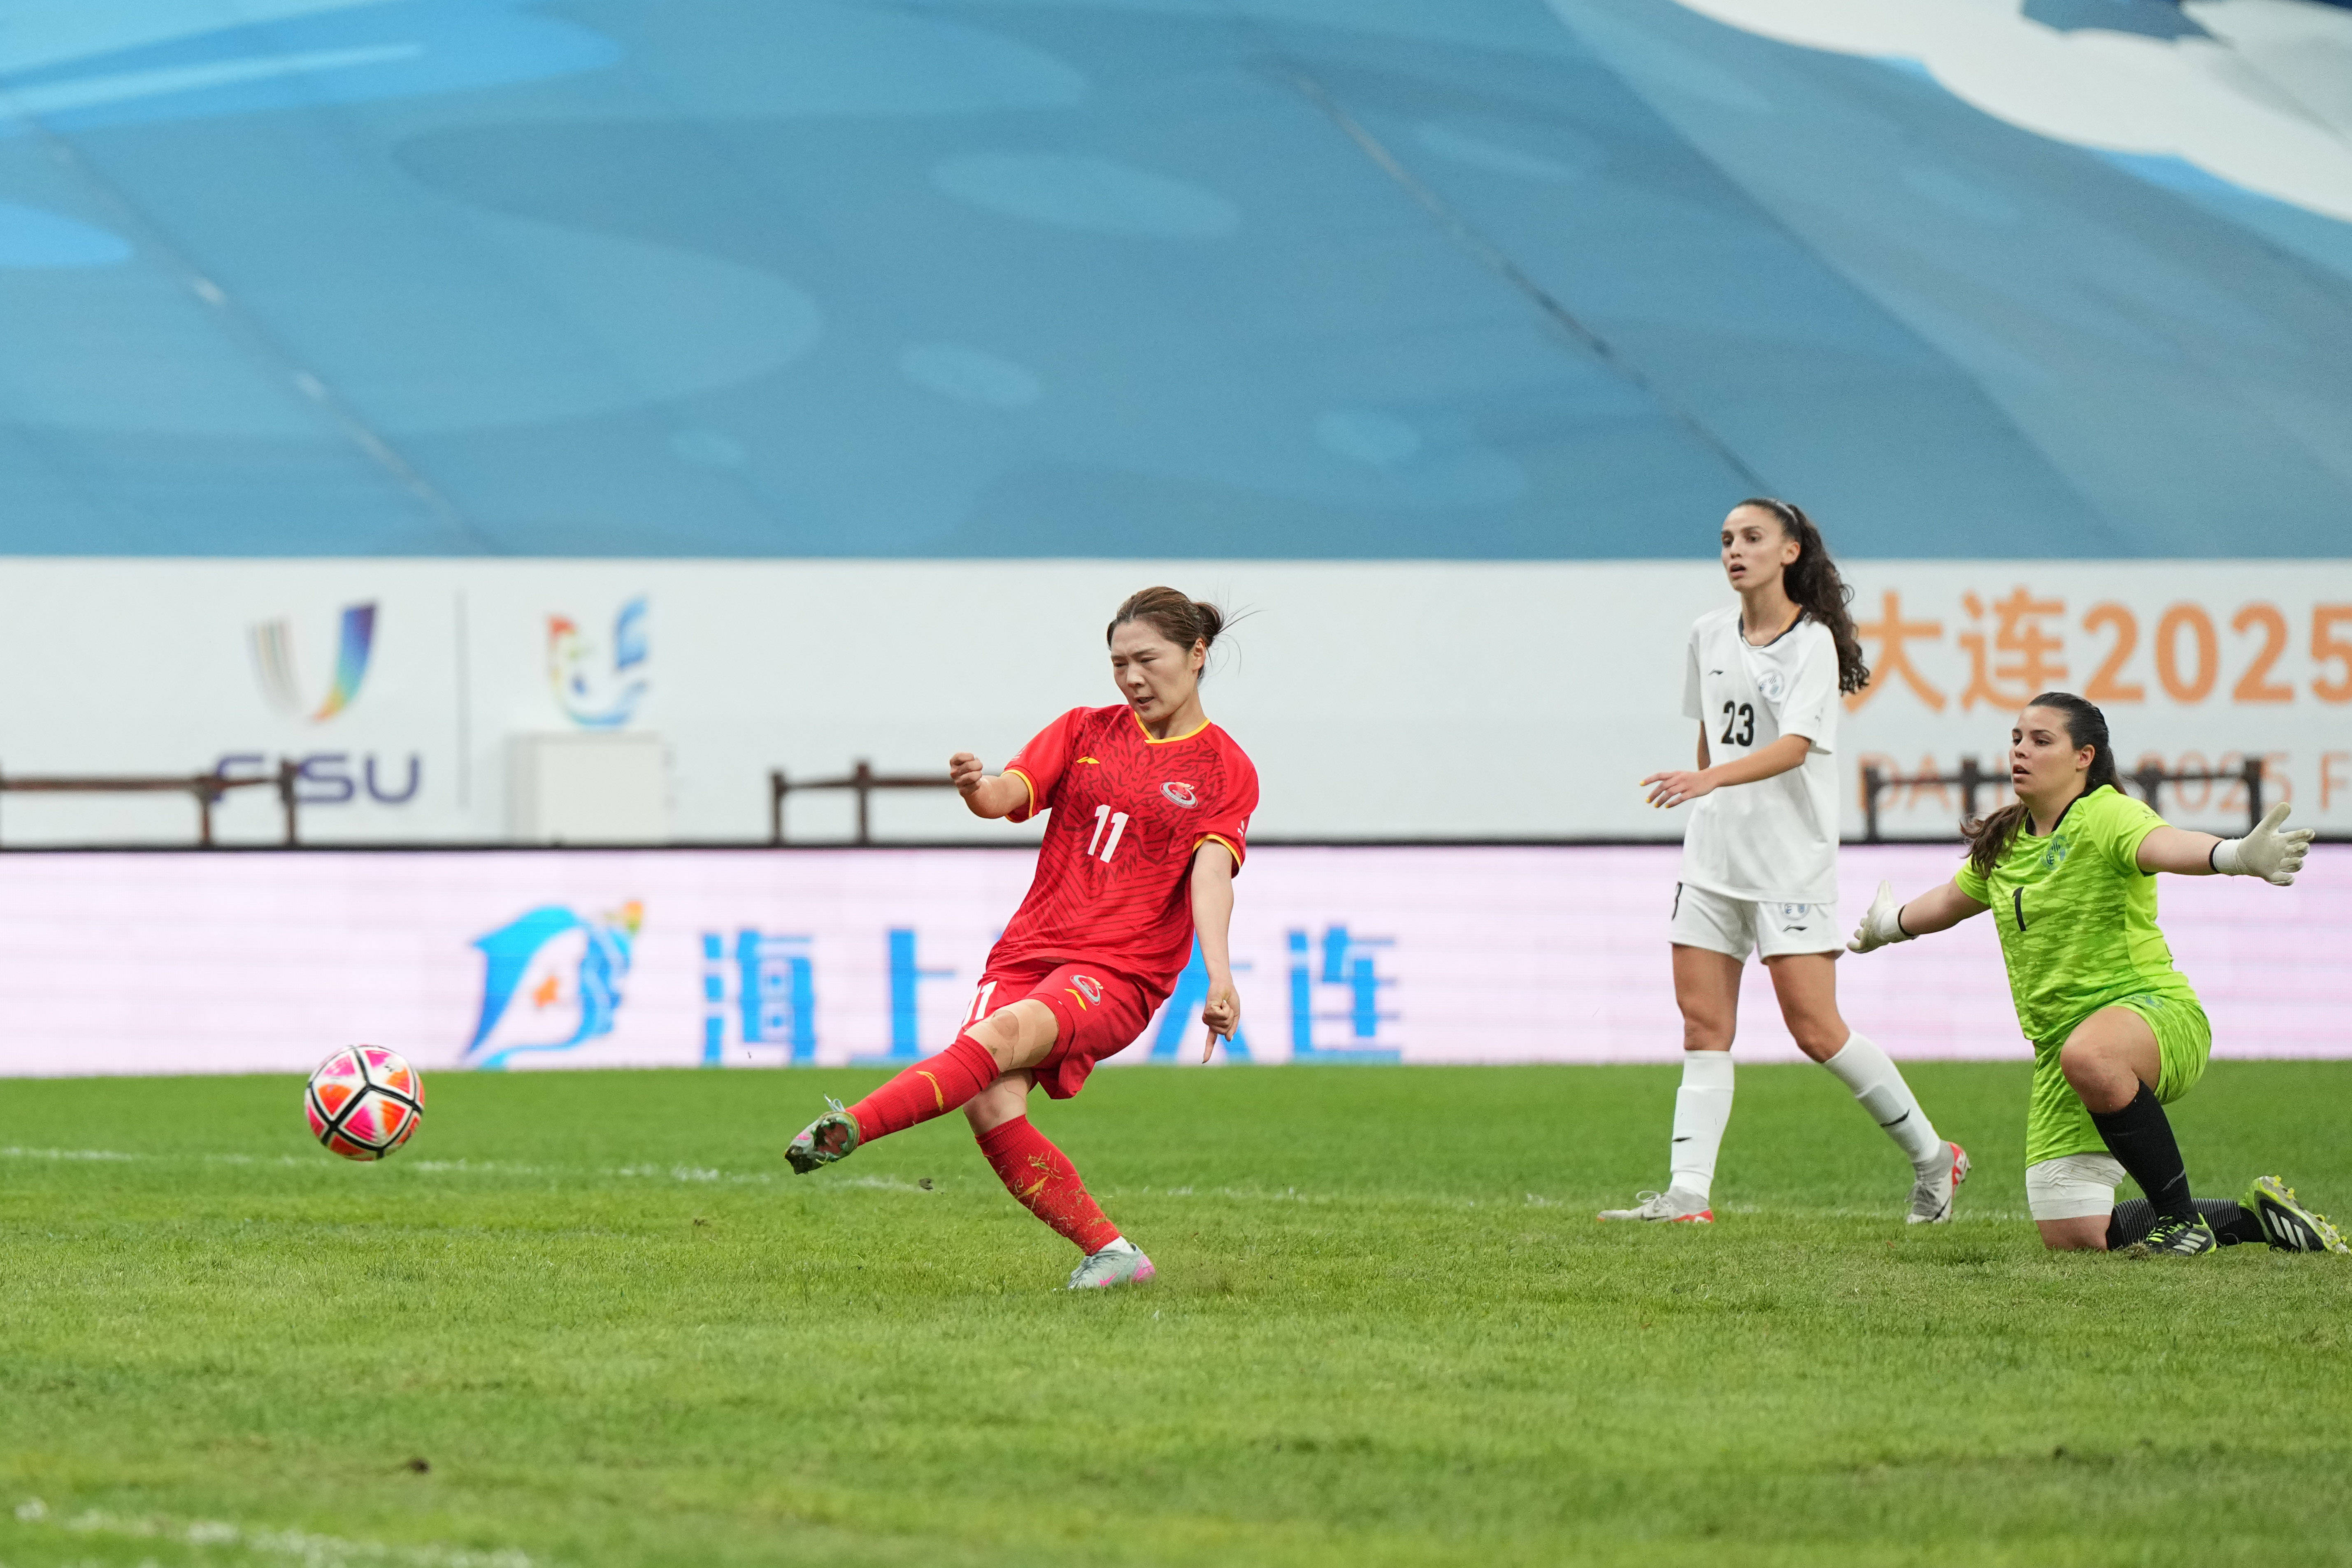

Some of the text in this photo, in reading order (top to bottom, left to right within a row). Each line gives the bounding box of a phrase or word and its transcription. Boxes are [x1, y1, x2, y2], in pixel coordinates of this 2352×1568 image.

[1721, 700, 1754, 747] 23
[213, 752, 420, 804] FSU
[1087, 804, 1130, 864] 11
[2012, 885, 2027, 932] 1
